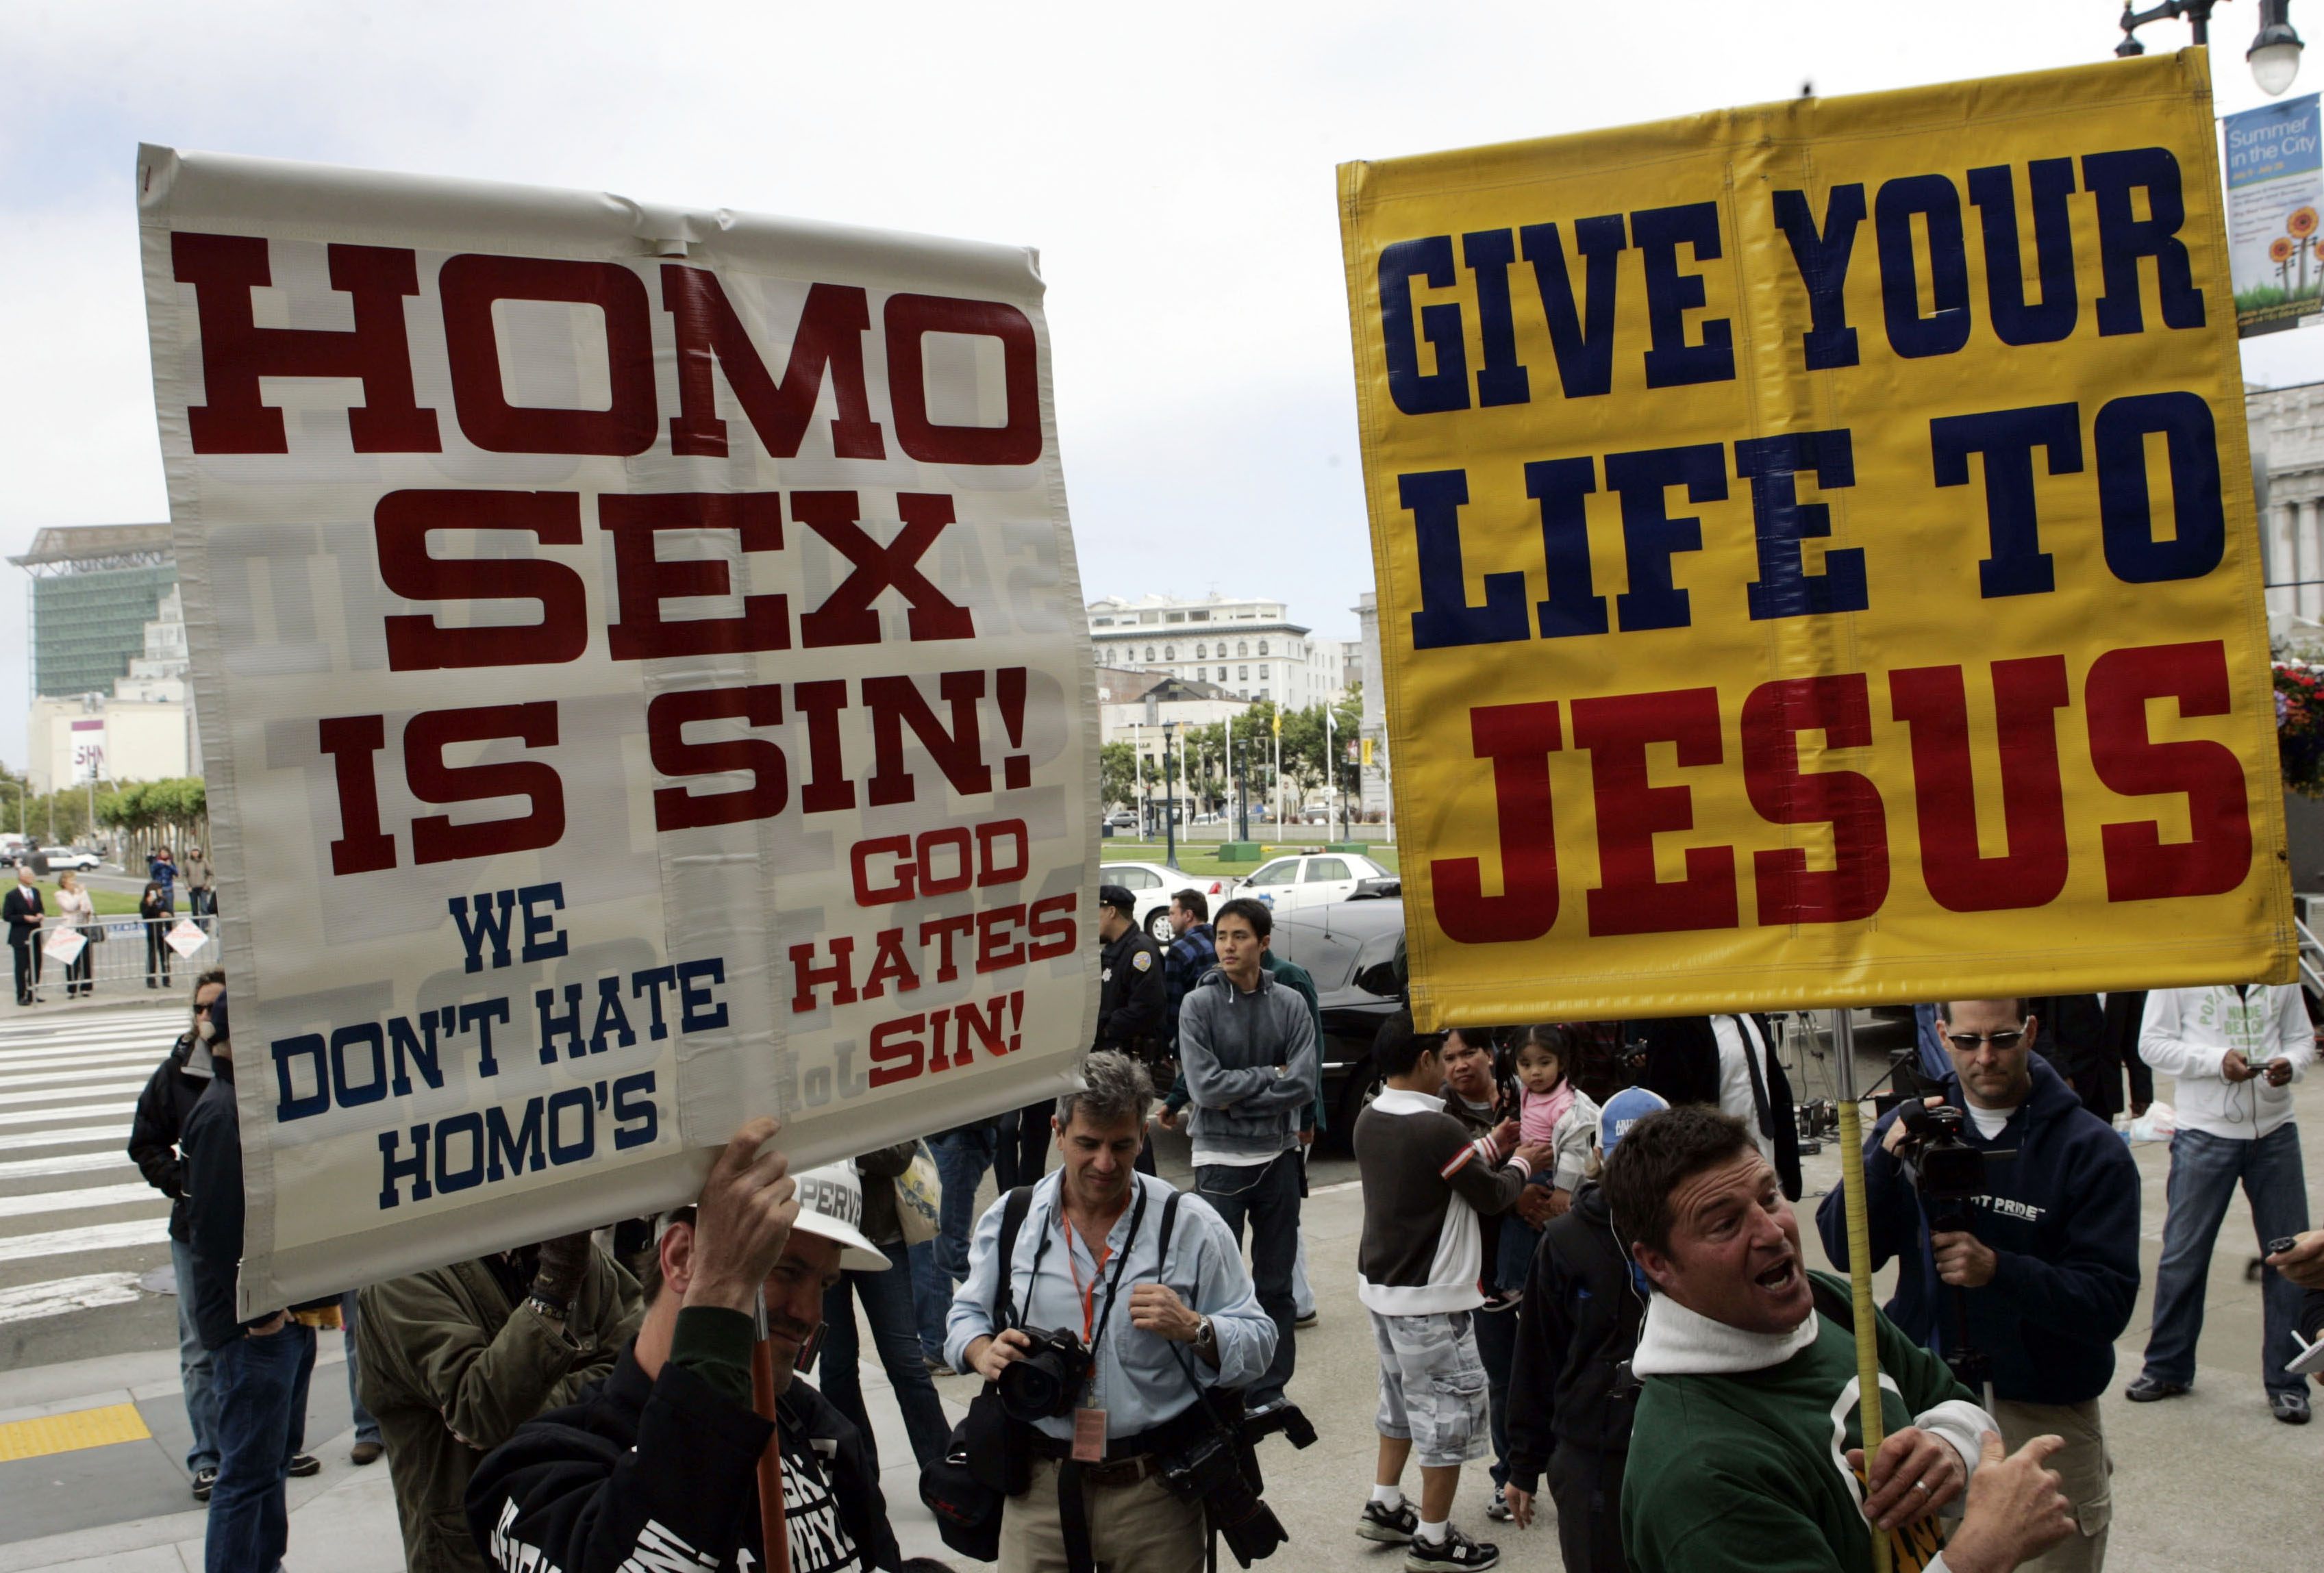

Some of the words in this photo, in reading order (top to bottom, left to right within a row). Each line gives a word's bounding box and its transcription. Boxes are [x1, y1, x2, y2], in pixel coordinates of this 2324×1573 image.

[2229, 116, 2310, 149] Summer
[2231, 150, 2247, 168] in
[2249, 144, 2279, 163] the
[2282, 134, 2317, 155] City
[171, 231, 1042, 464] HOMO
[1378, 201, 1736, 415] GIVE
[1773, 147, 2206, 370] YOUR
[374, 490, 975, 671] SEX
[1398, 429, 1869, 650] LIFE
[1930, 392, 2225, 599] TO
[319, 701, 565, 875] IS
[648, 667, 1030, 831] SIN!
[1432, 641, 2252, 944] JESUS
[449, 882, 568, 974] WE
[851, 819, 1028, 907] GOD
[790, 893, 1076, 1012] HATES
[271, 997, 510, 1122] DON'T
[536, 957, 729, 1065] HATE
[869, 991, 1023, 1087] SIN!
[379, 1071, 658, 1209] HOMO'S
[1994, 1197, 2038, 1218] PRIDE
